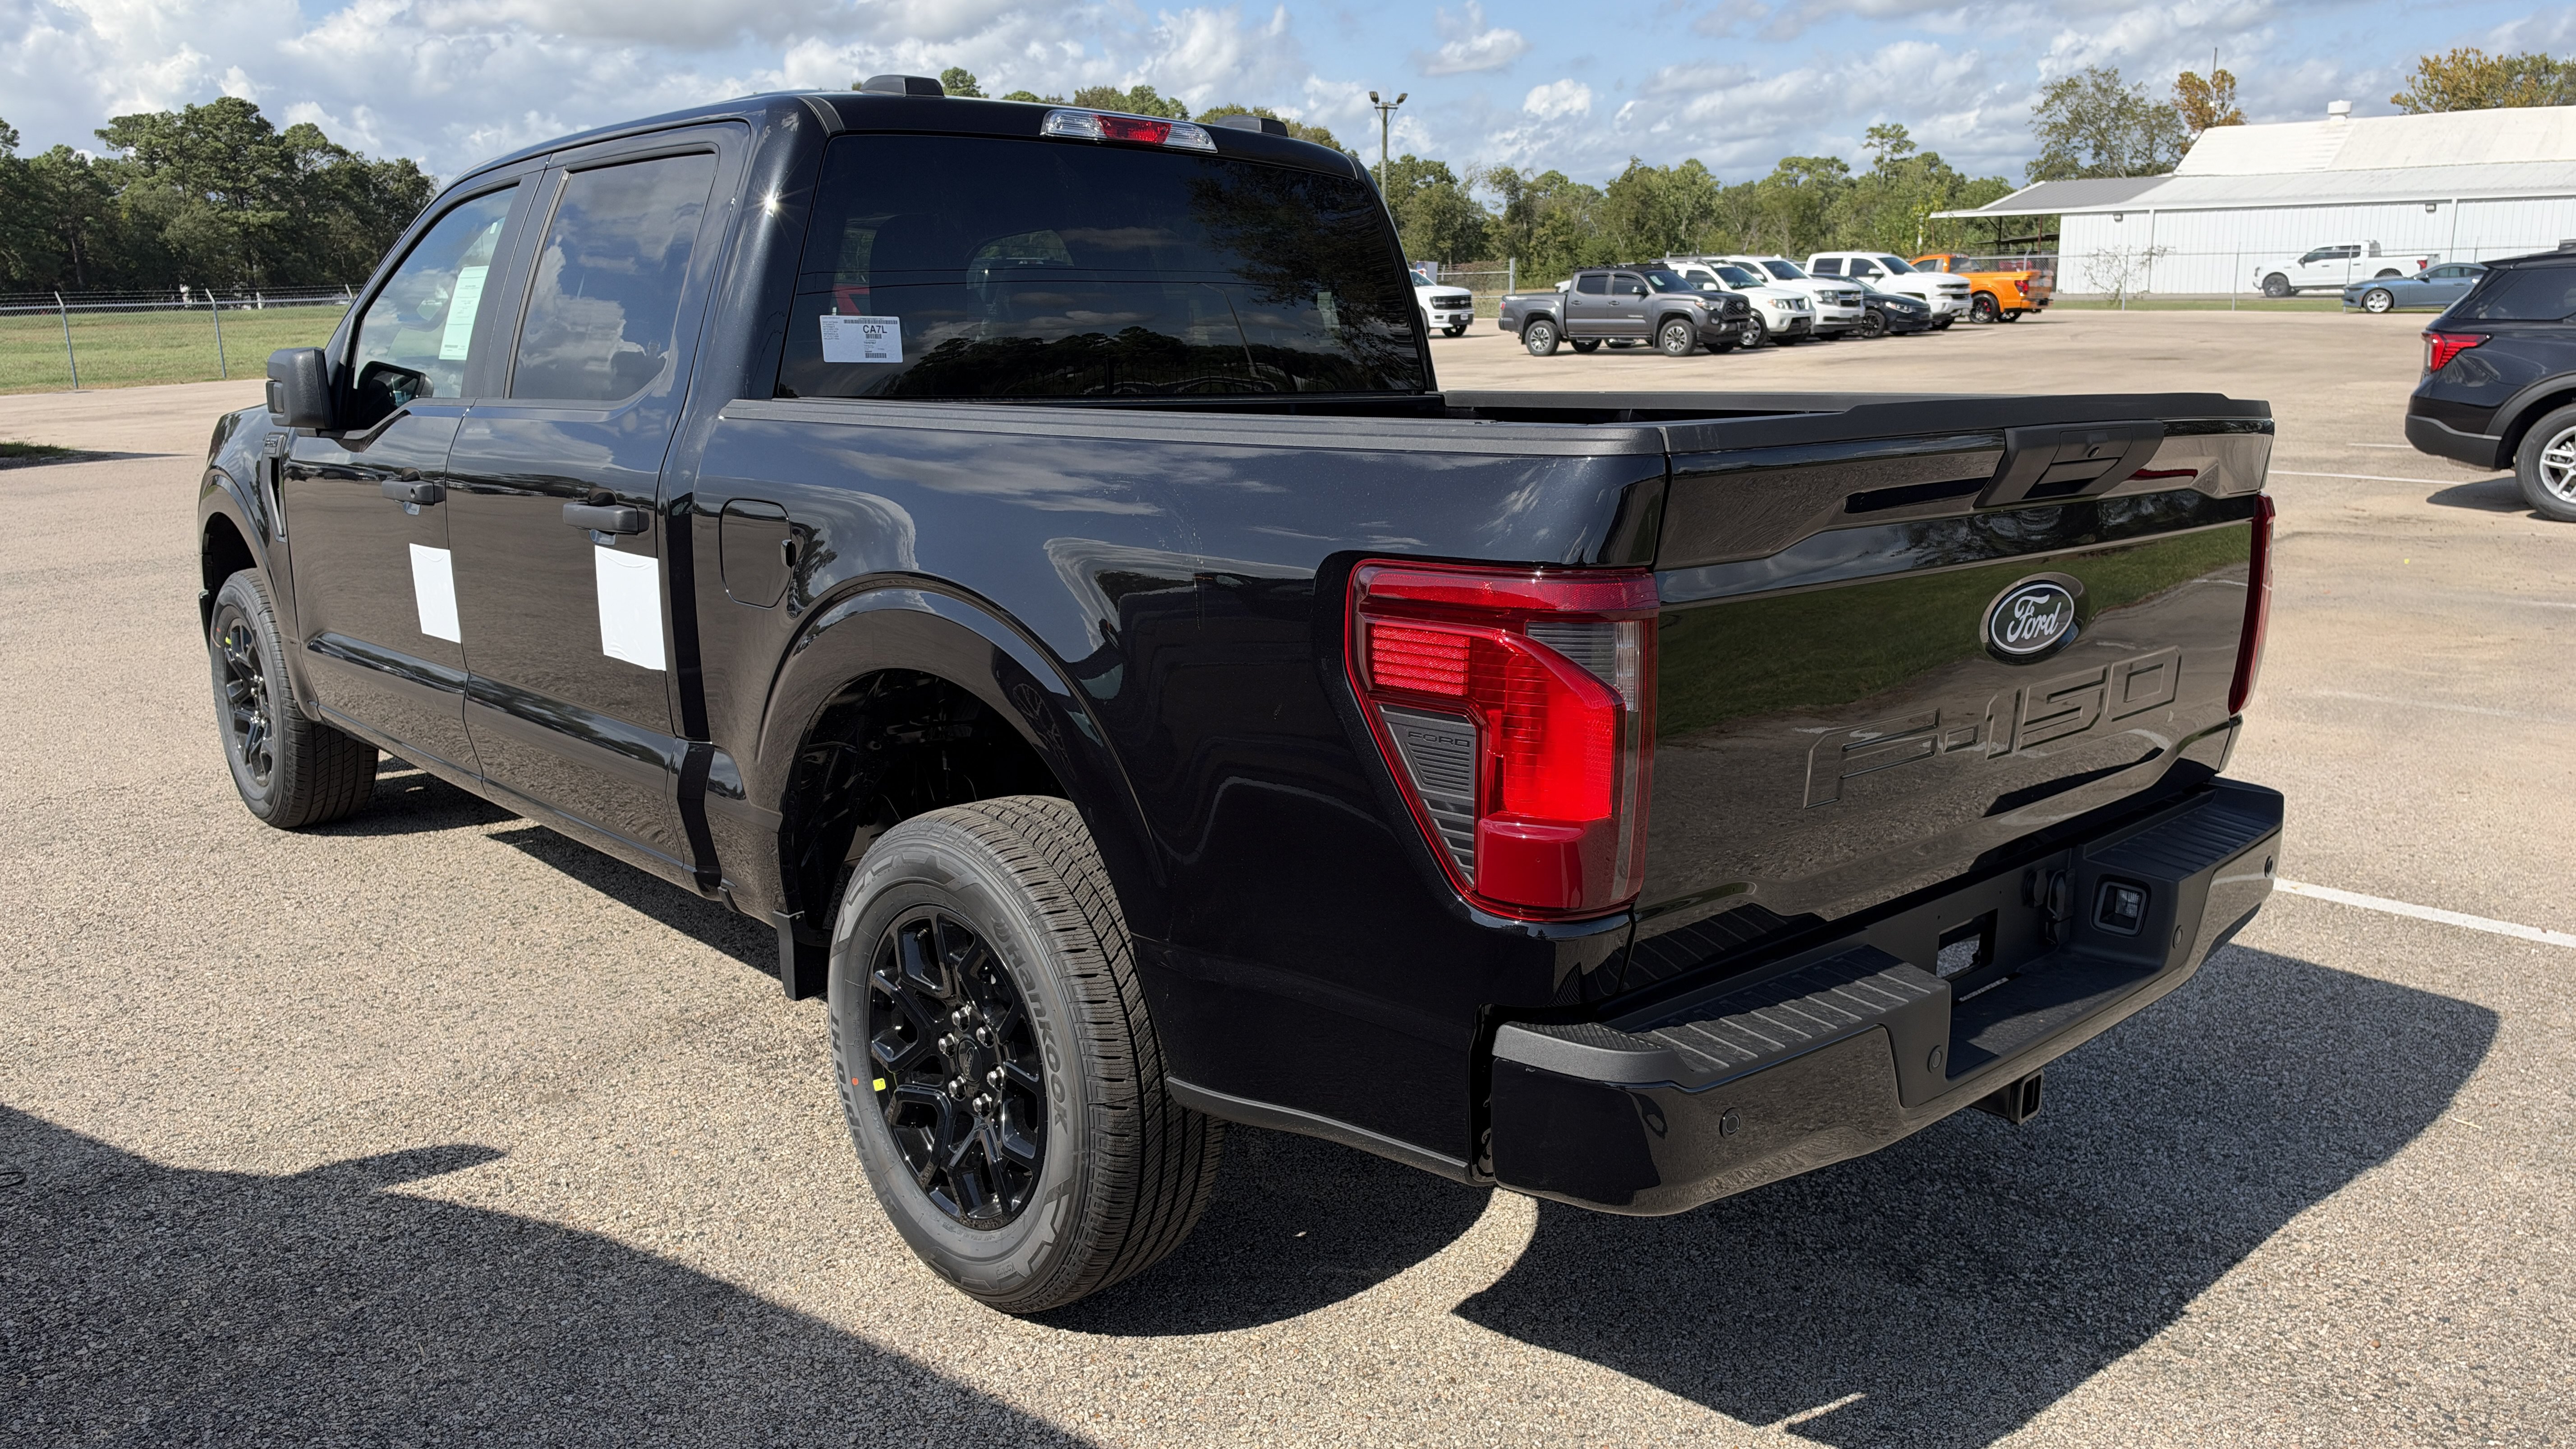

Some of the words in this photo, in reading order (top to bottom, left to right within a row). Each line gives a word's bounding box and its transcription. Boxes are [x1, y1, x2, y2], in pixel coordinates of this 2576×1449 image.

[863, 325, 888, 333] CA7L
[2007, 594, 2061, 643] Ford
[1408, 731, 1470, 748] FORD
[1804, 645, 2182, 810] F-150
[831, 1007, 842, 1054] HT
